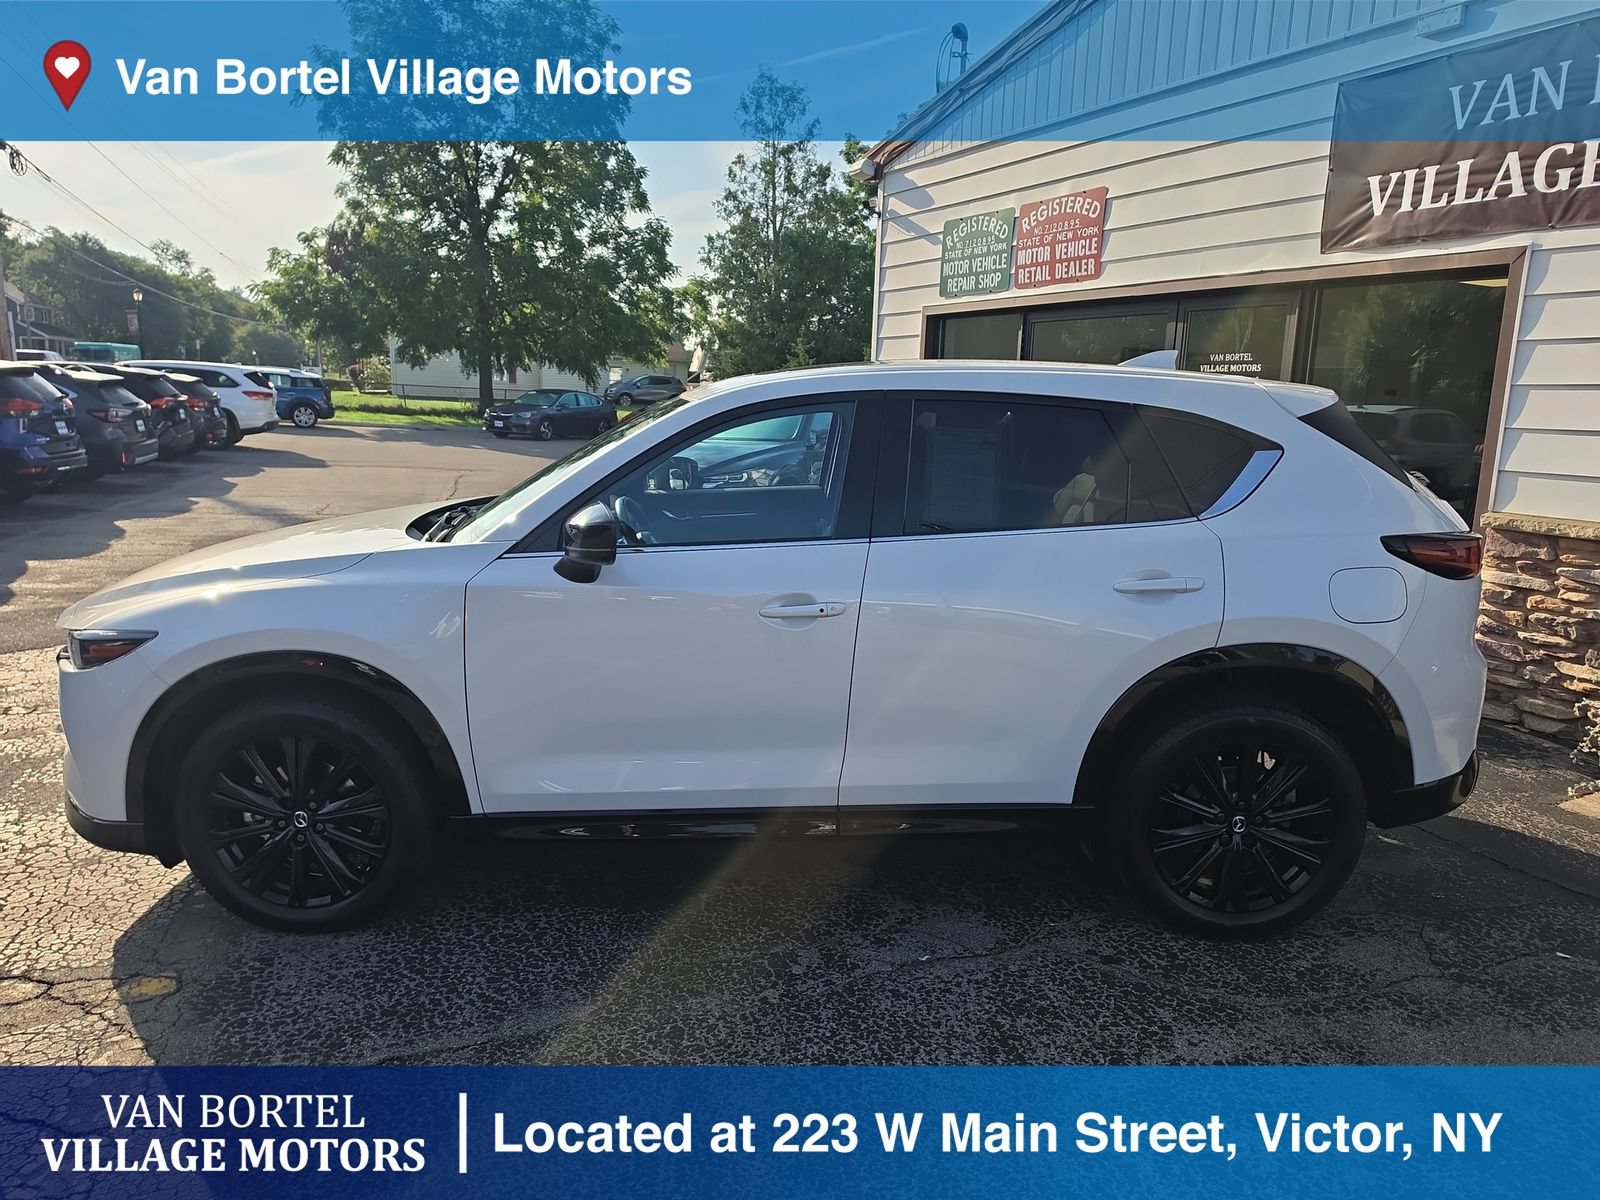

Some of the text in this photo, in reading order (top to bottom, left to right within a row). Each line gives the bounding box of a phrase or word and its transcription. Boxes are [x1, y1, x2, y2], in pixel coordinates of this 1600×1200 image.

[1449, 59, 1574, 130] VAN
[1022, 196, 1101, 233] REGISTERED
[1044, 218, 1081, 234] 7120895
[946, 215, 1009, 250] REGISTERED
[964, 234, 996, 248] 7120895
[1018, 225, 1100, 248] STATE OF NEW YORK
[944, 241, 1008, 260] STATE OF NEW YORK
[1017, 237, 1099, 266] MOTOR VEHICLE
[942, 252, 1008, 277] MOTOR VEHICLE
[1018, 258, 1096, 284] RETAIL DEALER
[947, 271, 1002, 293] REPAIR SHOP
[1225, 353, 1252, 361] BORTEL
[1230, 364, 1261, 372] MOTORS
